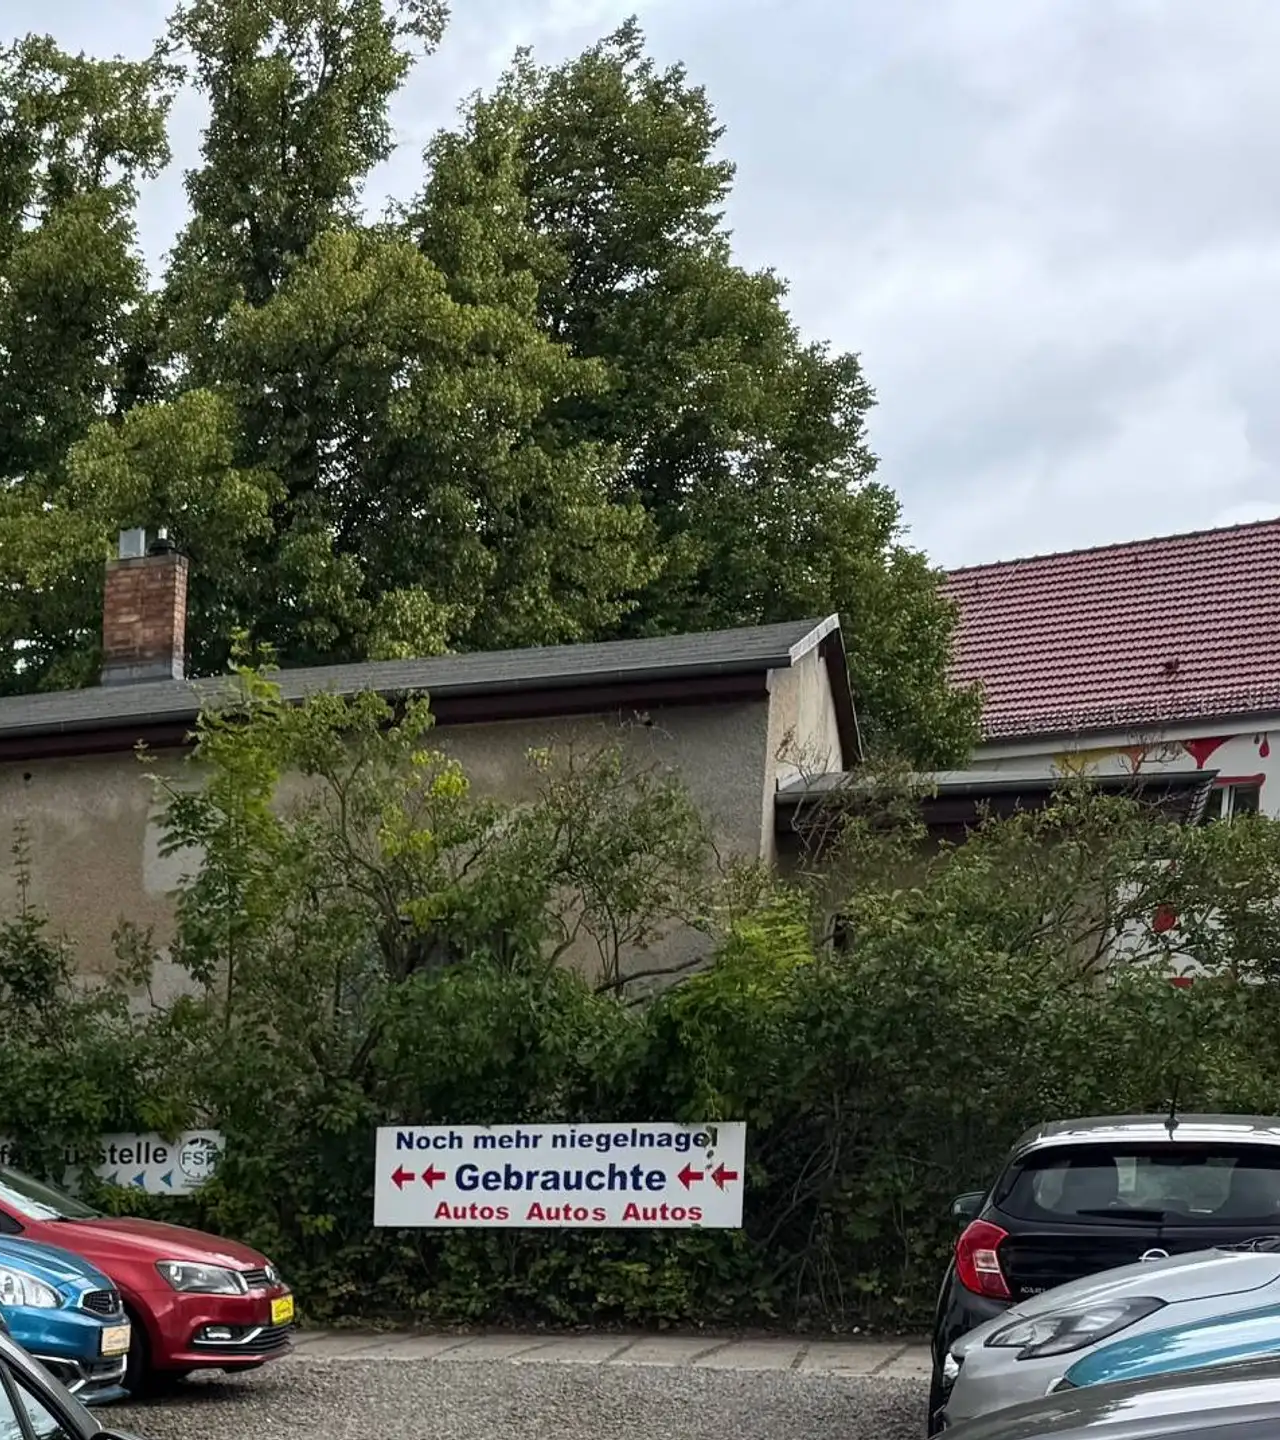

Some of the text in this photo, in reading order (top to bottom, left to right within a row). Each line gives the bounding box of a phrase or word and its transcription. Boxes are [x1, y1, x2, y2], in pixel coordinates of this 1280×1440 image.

[395, 1127, 718, 1153] Noch mehr niegelnagel
[454, 1163, 667, 1193] Gebrauchte
[435, 1202, 703, 1221] Autos Autos Autos
